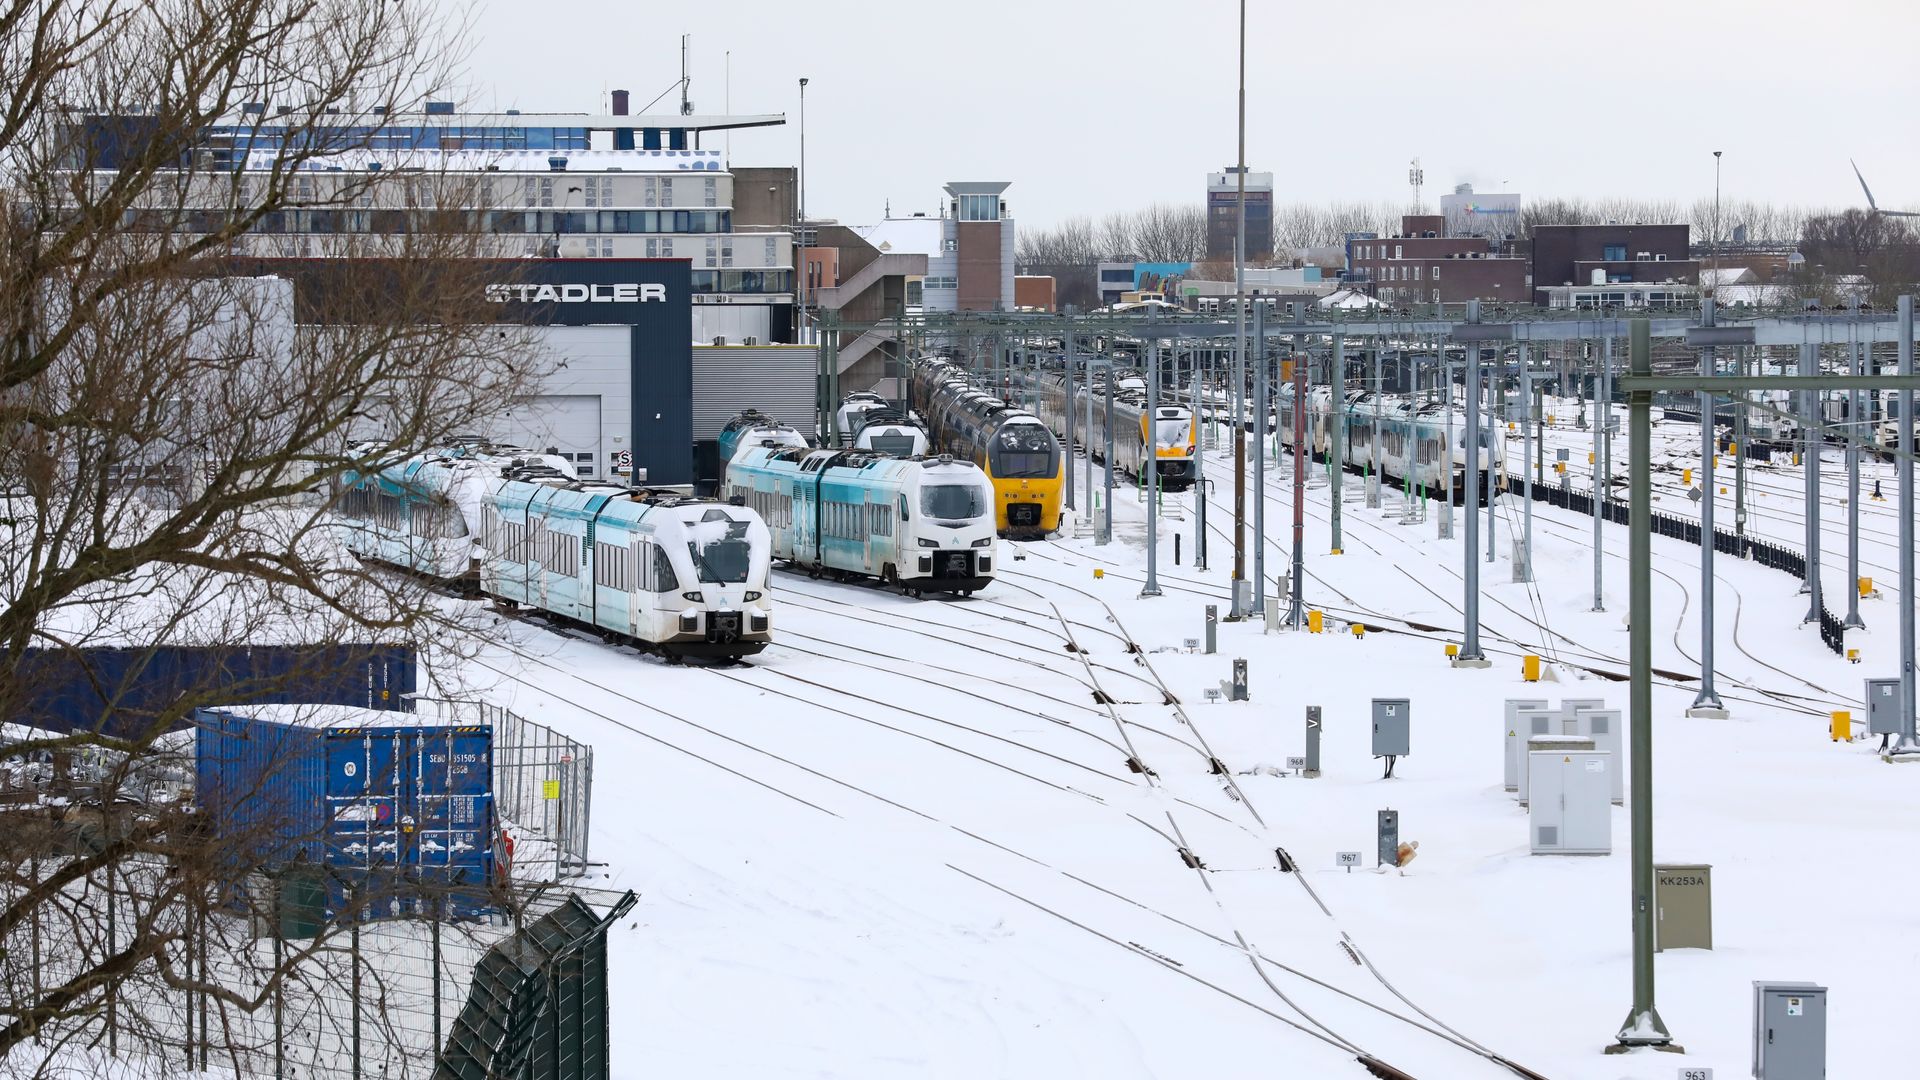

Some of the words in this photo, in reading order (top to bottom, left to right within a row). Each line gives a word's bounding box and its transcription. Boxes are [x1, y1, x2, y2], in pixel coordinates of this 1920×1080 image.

[485, 283, 666, 303] STADLER
[1290, 758, 1304, 766] 968
[1341, 854, 1357, 862] 967
[1660, 876, 1705, 886] KK253A
[1685, 1071, 1706, 1080] 963
